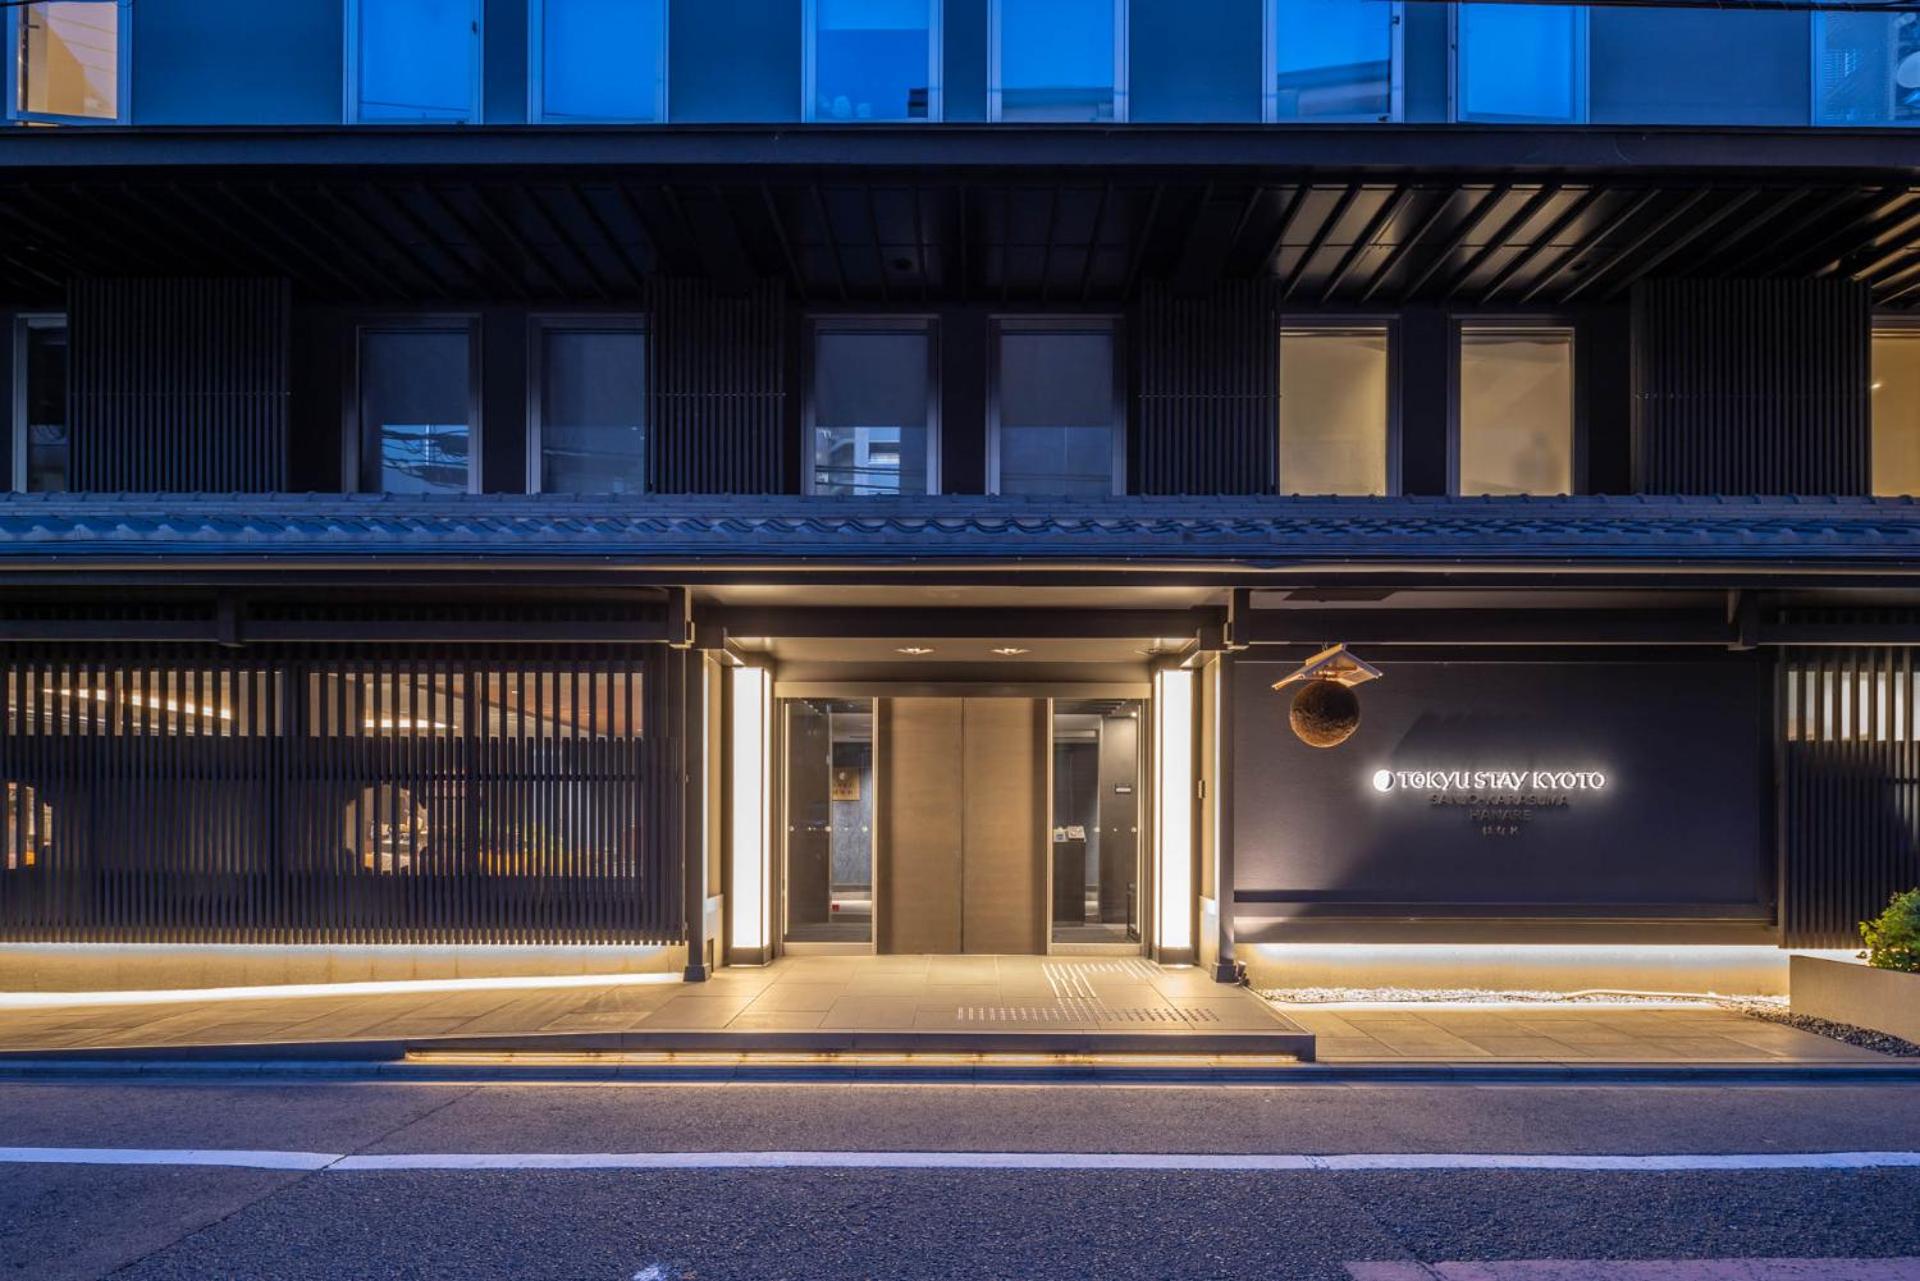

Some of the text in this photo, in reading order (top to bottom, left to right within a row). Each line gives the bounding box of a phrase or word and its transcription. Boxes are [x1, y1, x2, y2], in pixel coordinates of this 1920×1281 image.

[1397, 771, 1606, 790] TOKYU STAY KYOTO
